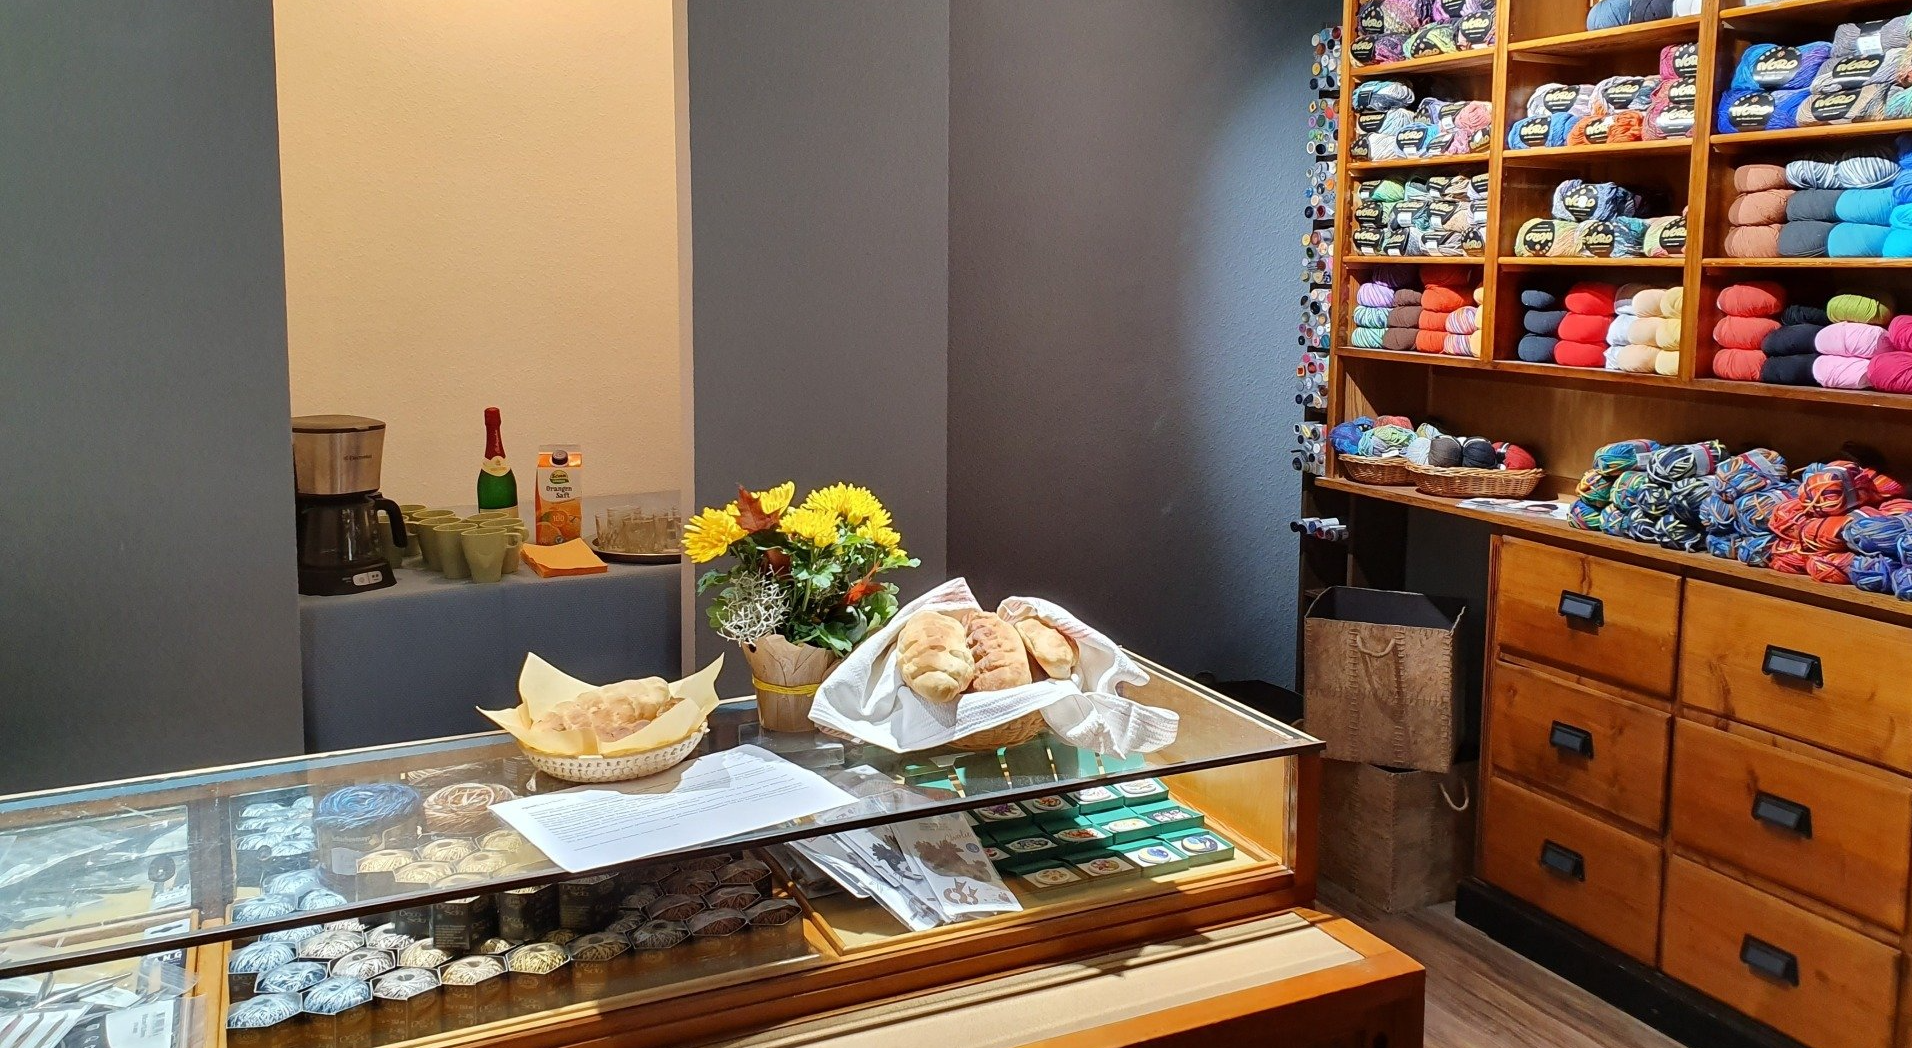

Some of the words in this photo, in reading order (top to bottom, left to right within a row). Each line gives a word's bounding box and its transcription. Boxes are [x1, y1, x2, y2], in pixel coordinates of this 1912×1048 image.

[1461, 17, 1489, 30] NORO
[1756, 58, 1799, 72] NORO
[1836, 58, 1880, 72] NORO
[1544, 90, 1576, 101] NORO
[1670, 83, 1696, 97] NOR
[1814, 94, 1857, 108] NORO
[1521, 122, 1548, 136] NORO
